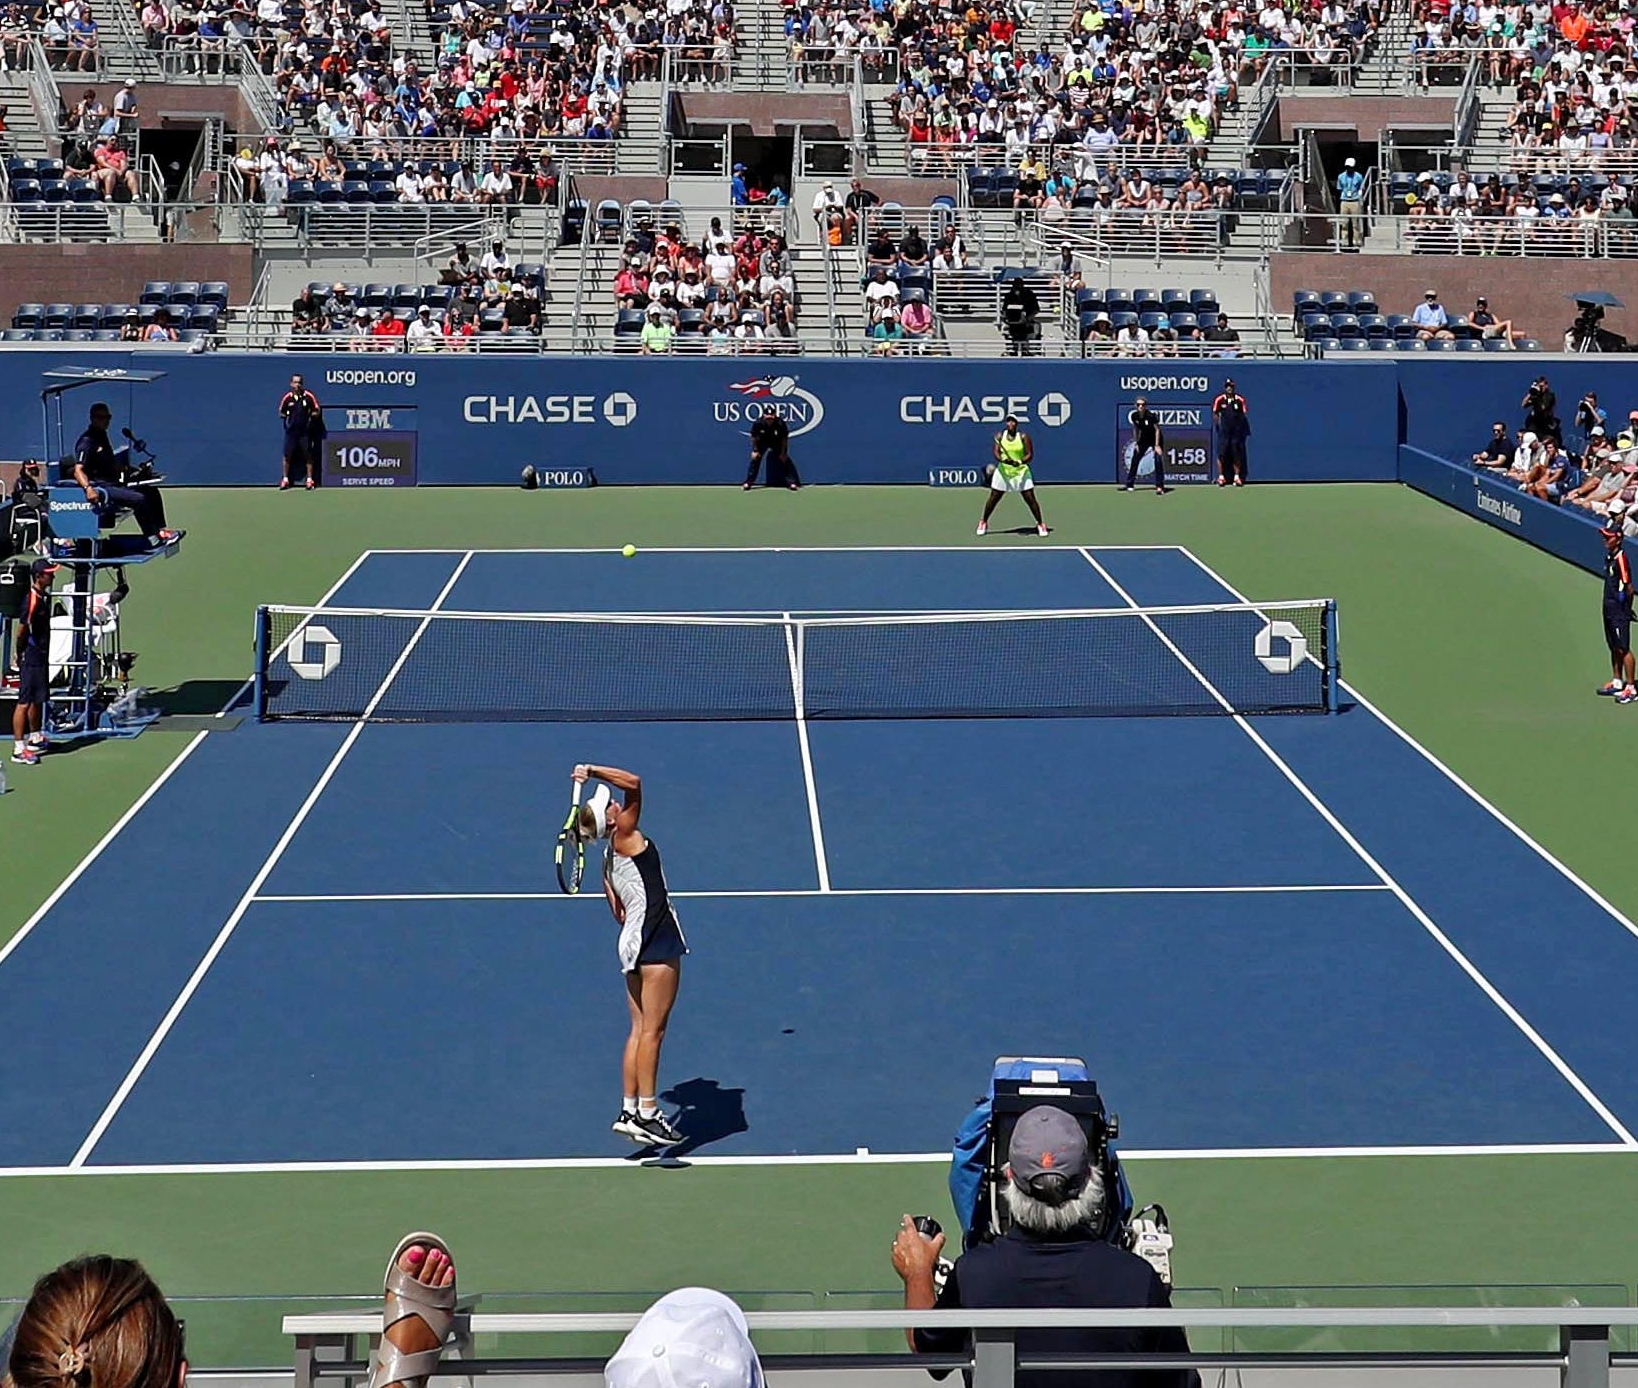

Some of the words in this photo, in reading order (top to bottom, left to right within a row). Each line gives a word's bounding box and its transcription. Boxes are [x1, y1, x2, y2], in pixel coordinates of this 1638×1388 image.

[326, 370, 416, 386] usopen.org
[1121, 376, 1208, 392] usopen.org
[464, 396, 596, 423] CHASE
[713, 402, 740, 422] US
[900, 396, 1031, 423] CHASE
[345, 409, 391, 429] IBM
[1167, 448, 1206, 465] 1:58
[544, 470, 583, 486] POLO
[938, 469, 977, 484] POLO
[1164, 473, 1190, 481] MATCH
[1191, 473, 1209, 481] TIME
